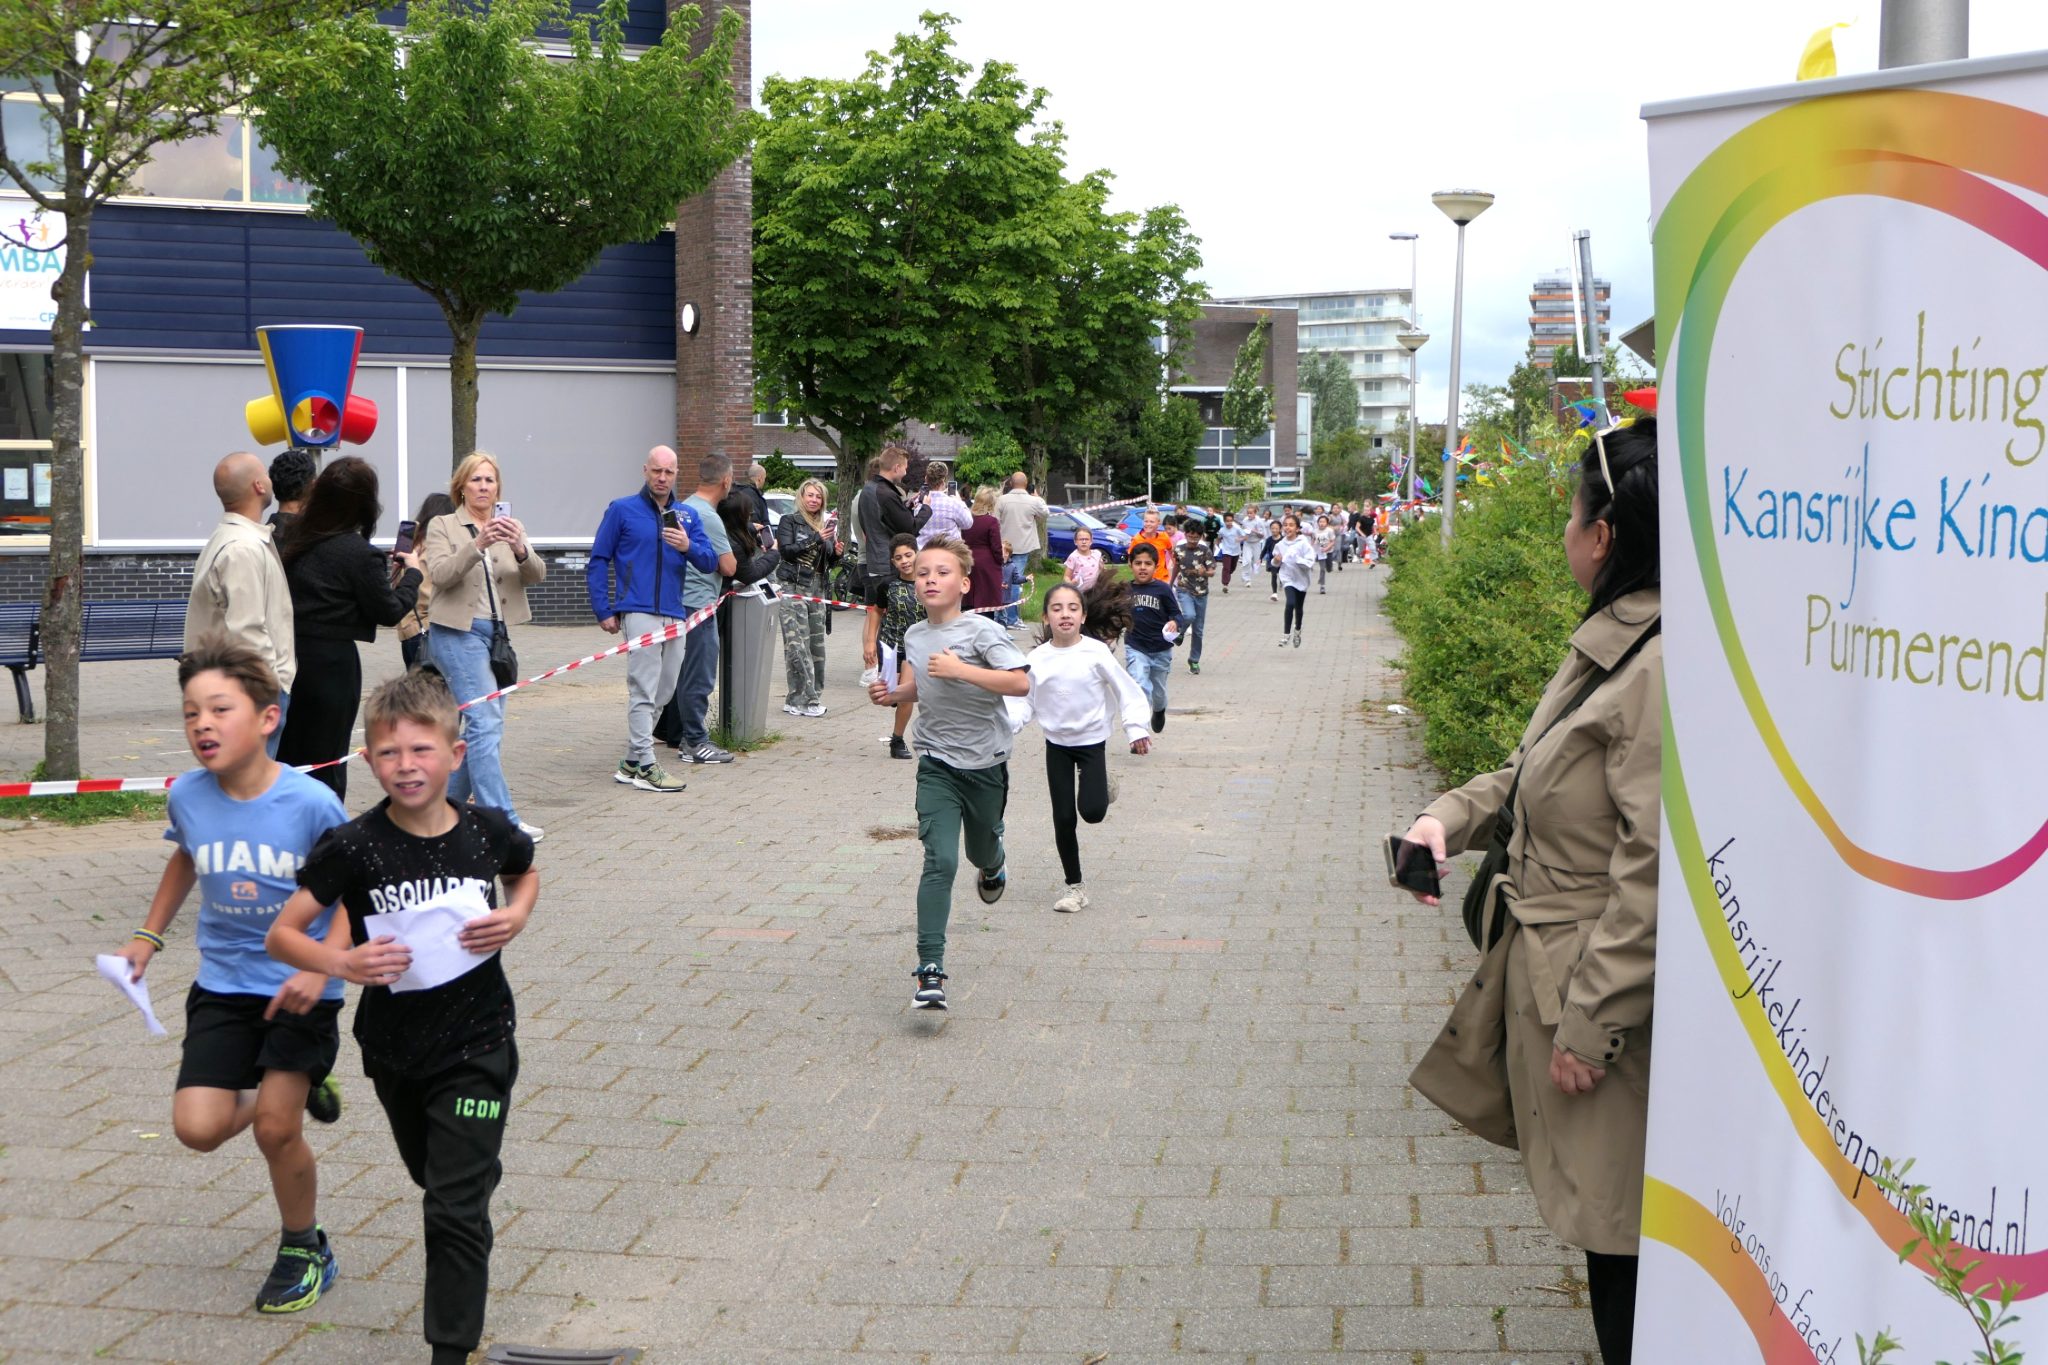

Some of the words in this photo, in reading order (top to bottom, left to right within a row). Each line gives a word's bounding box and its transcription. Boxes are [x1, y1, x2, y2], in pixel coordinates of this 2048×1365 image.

[0, 248, 62, 273] MBA
[1829, 310, 2048, 467] Stichting
[1724, 441, 1916, 610] Kansrijke
[1805, 590, 2048, 702] Purmerend
[1716, 1189, 1746, 1254] Volg
[1746, 1234, 1771, 1274] ons
[1769, 1271, 1788, 1317] op
